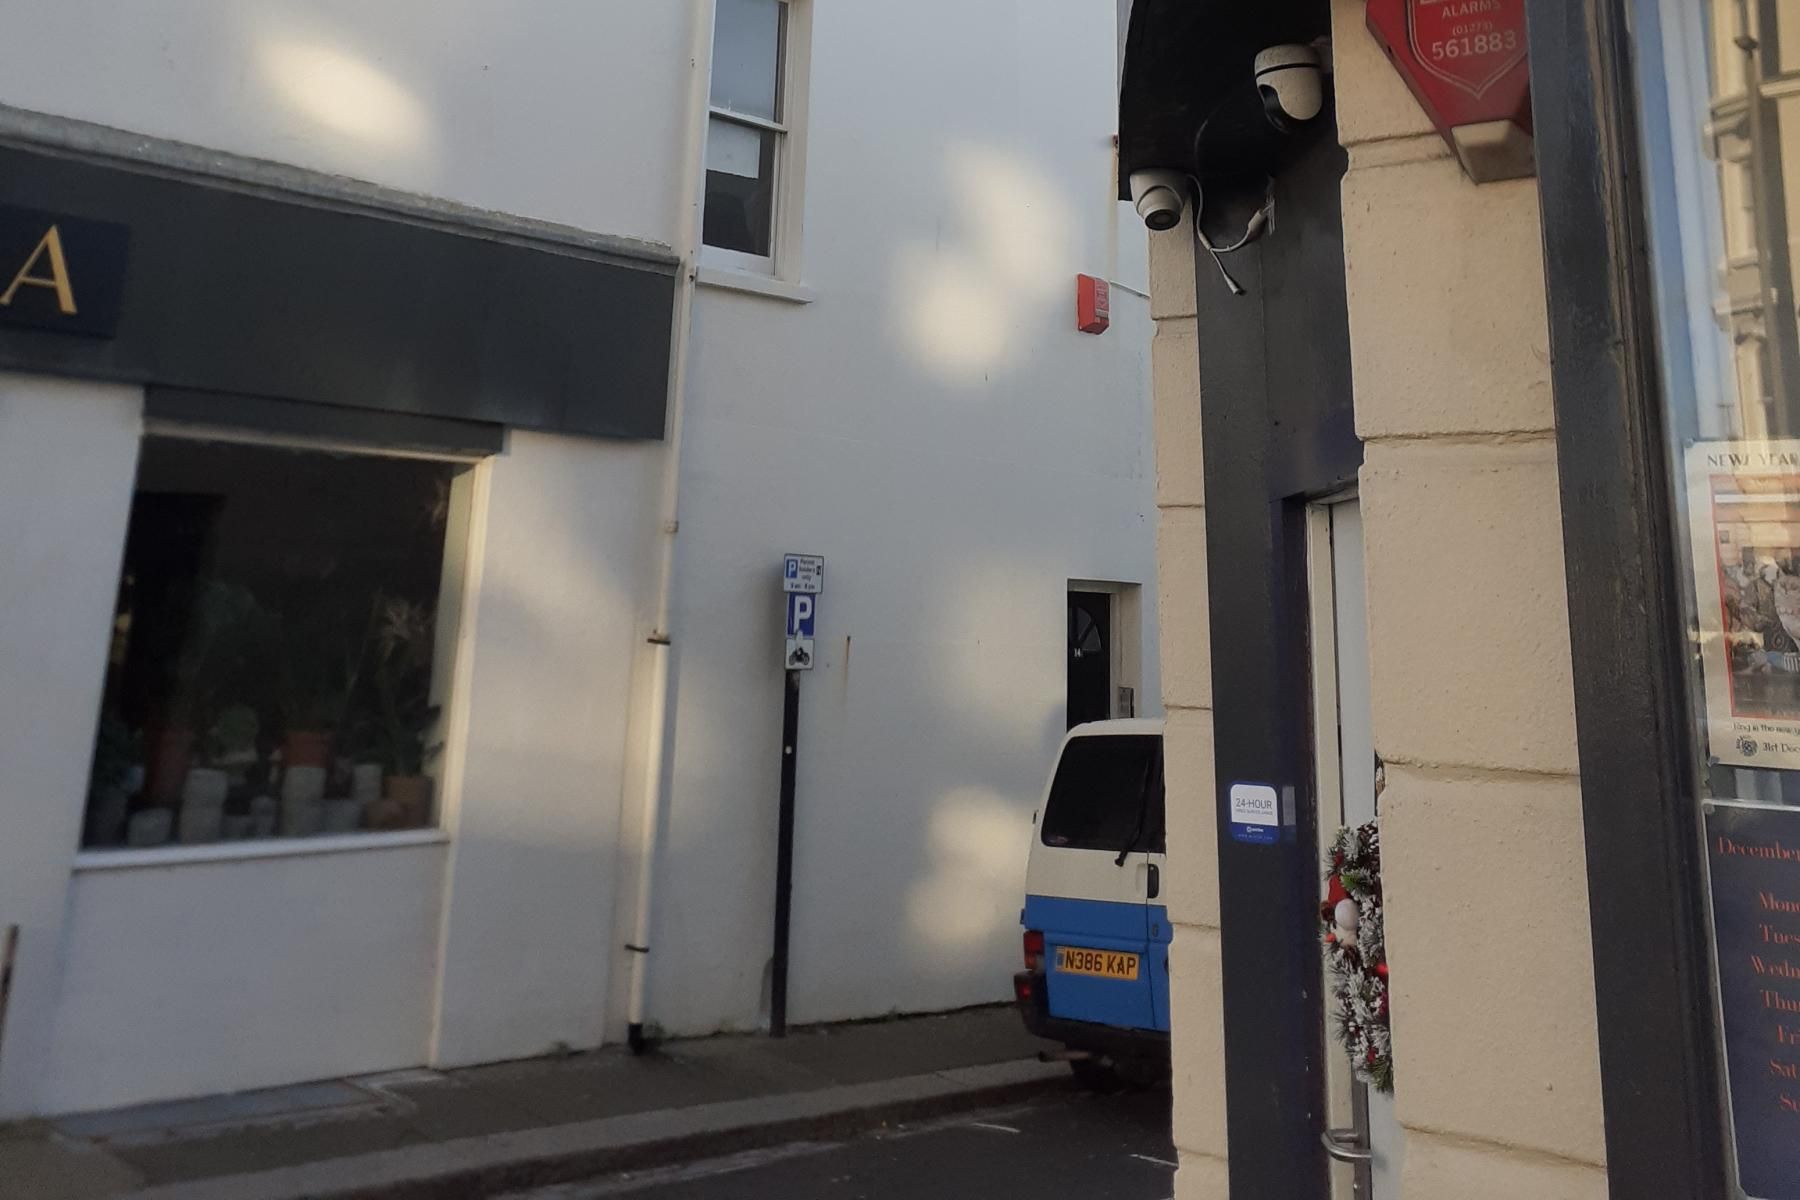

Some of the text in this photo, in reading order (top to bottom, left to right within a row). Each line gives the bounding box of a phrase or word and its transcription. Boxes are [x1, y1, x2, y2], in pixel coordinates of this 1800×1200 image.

[1442, 0, 1502, 19] ALARMS
[1432, 30, 1517, 61] 561883
[0, 223, 78, 315] A
[793, 595, 813, 634] P
[1235, 798, 1273, 810] 24-HOUR
[1065, 951, 1137, 976] N386 KAP
